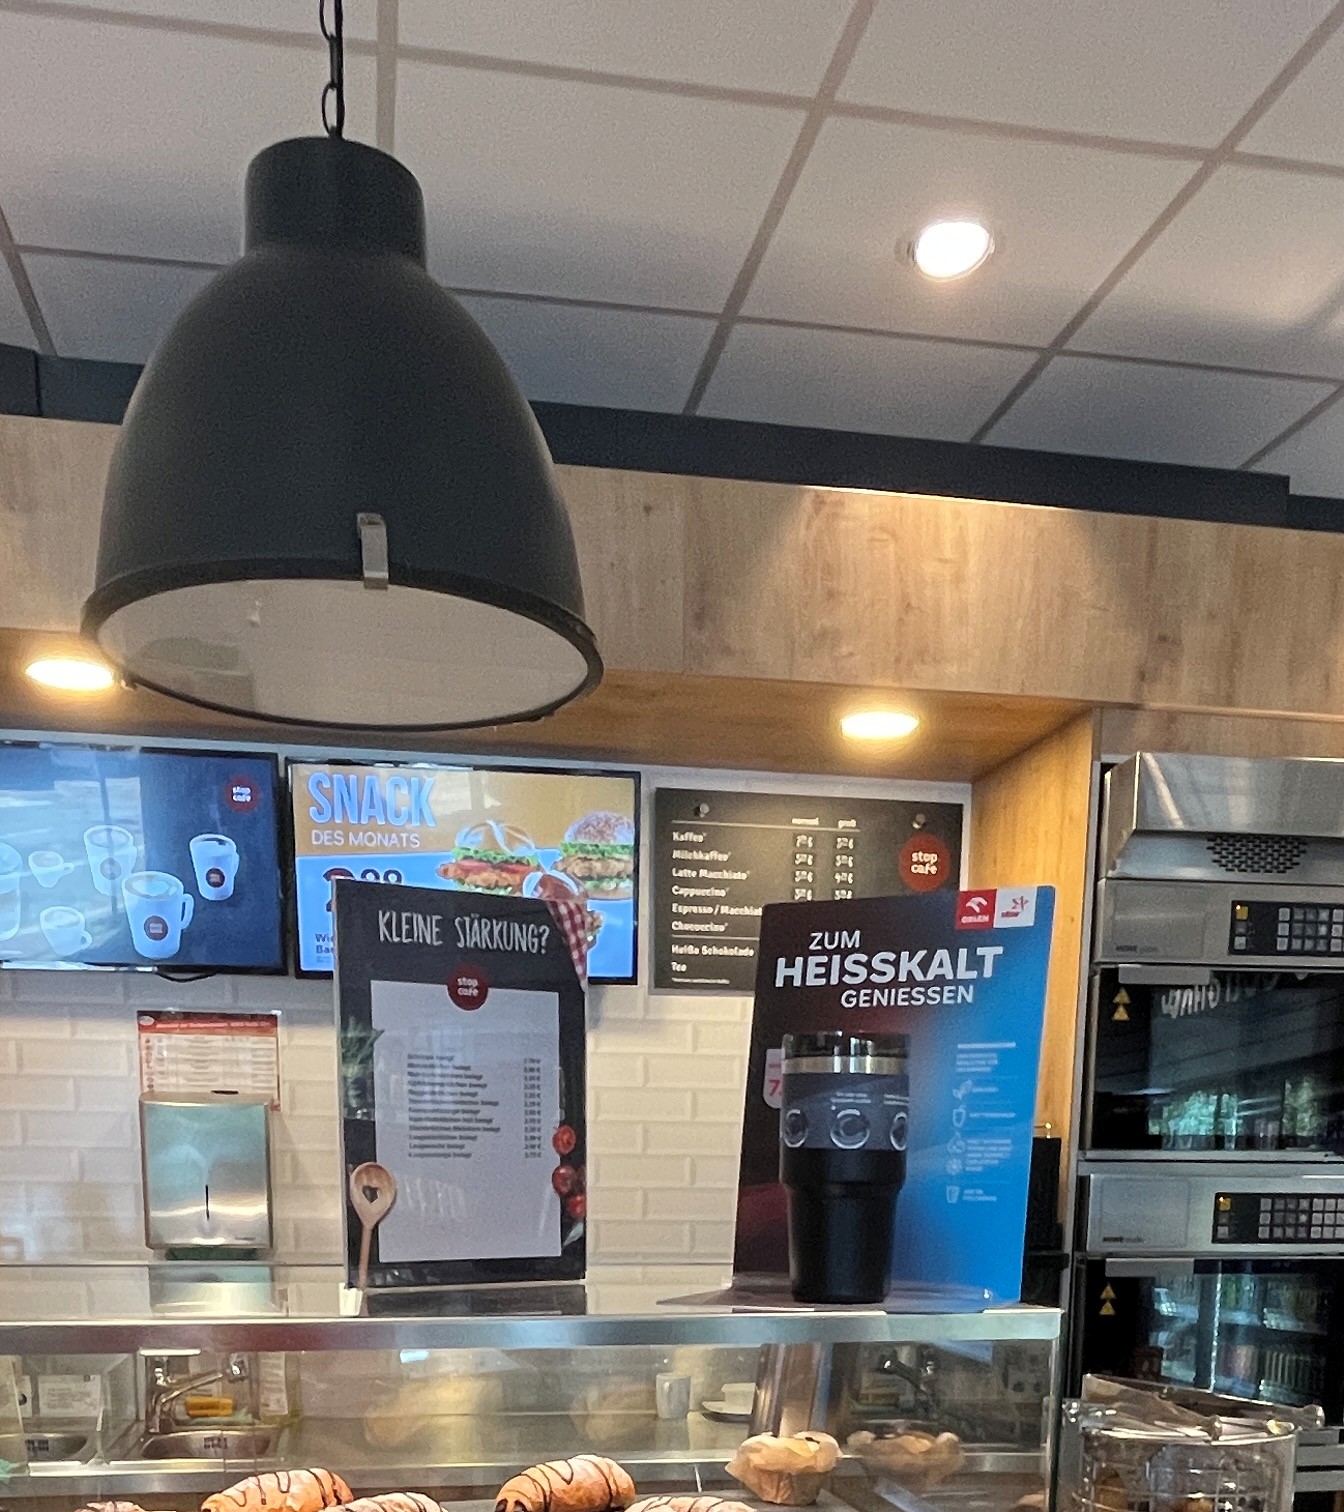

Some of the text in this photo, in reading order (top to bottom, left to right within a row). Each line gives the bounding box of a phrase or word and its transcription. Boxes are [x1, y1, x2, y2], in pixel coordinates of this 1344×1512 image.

[307, 770, 438, 829] SNACK
[311, 829, 422, 849] DES MONATS
[910, 851, 939, 865] stop
[377, 909, 551, 956] KLEINE STÄRKUNG?
[808, 929, 862, 951] ZUM
[774, 945, 1005, 989] HEISSKALT
[457, 976, 479, 988] stop
[457, 986, 480, 998] cafe
[840, 984, 975, 1009] GENIESSEN
